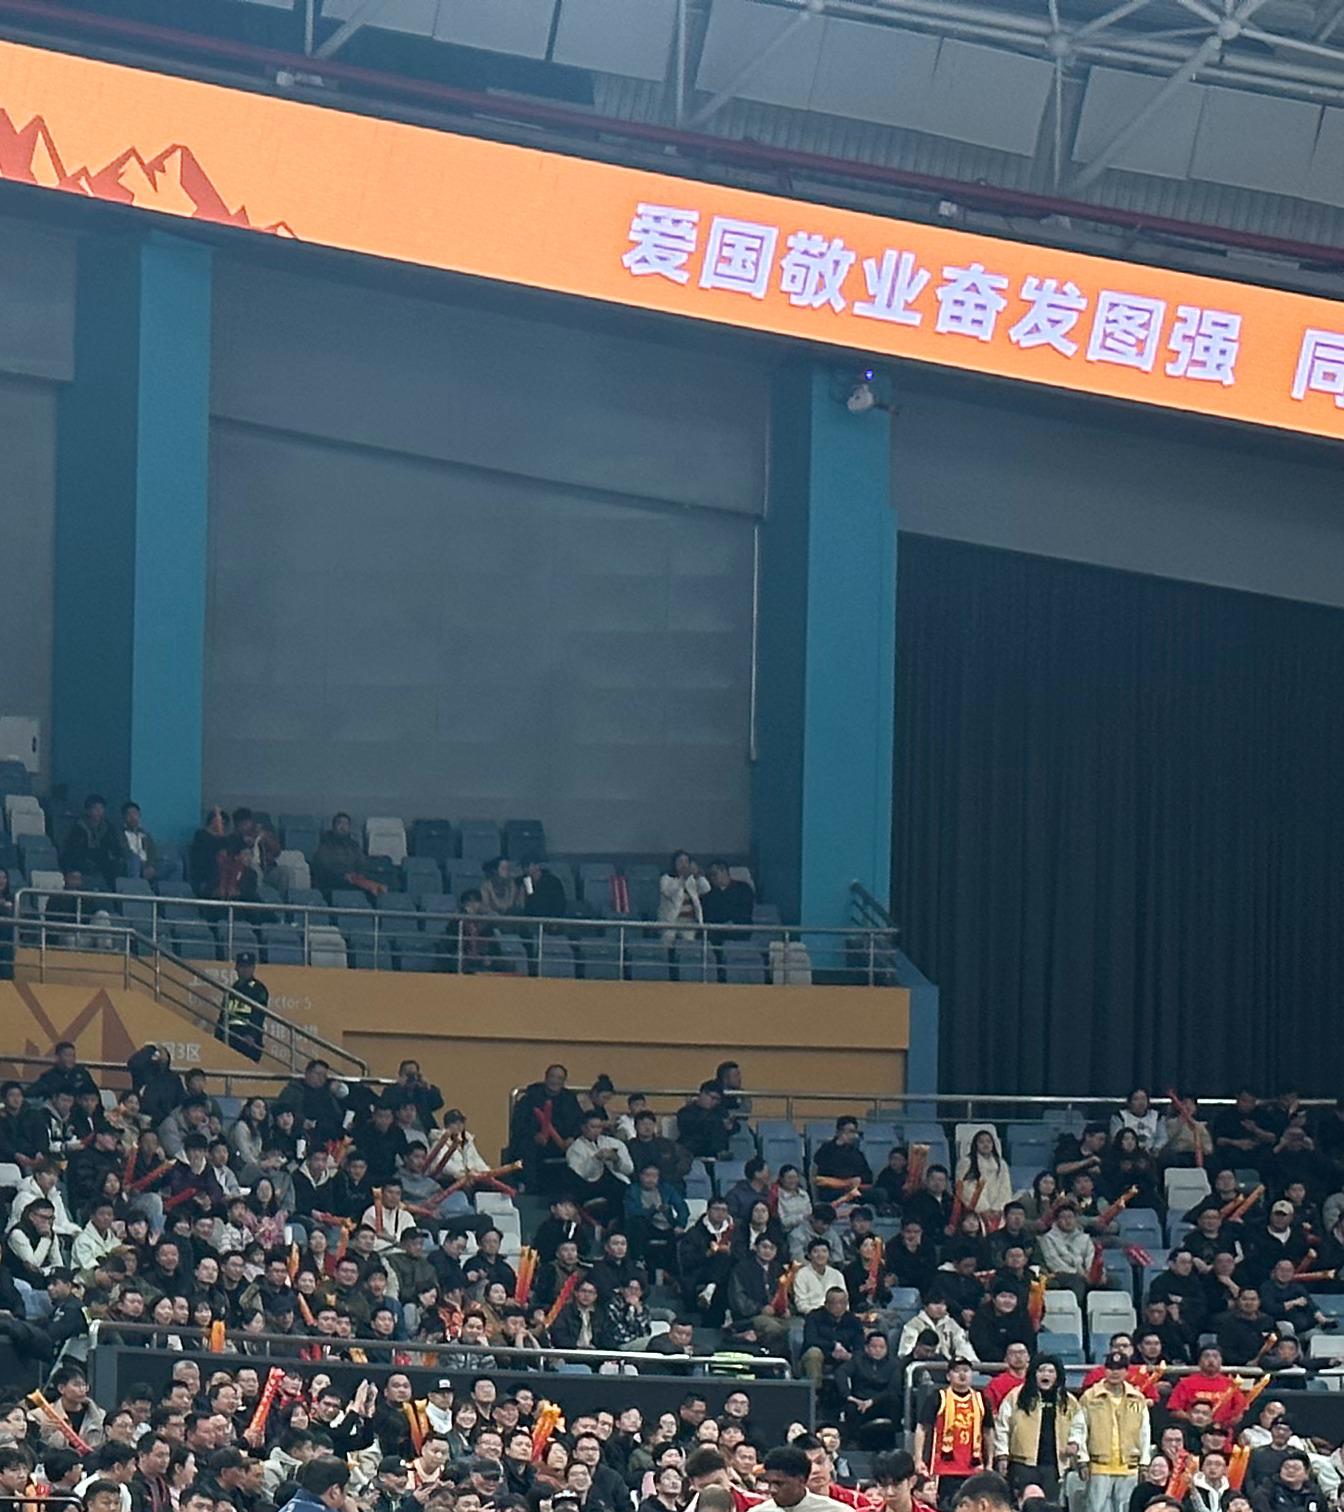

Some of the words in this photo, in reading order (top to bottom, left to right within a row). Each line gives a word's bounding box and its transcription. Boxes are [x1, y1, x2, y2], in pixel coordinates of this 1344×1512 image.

[620, 201, 1244, 386] 爱国敬业奋发图强
